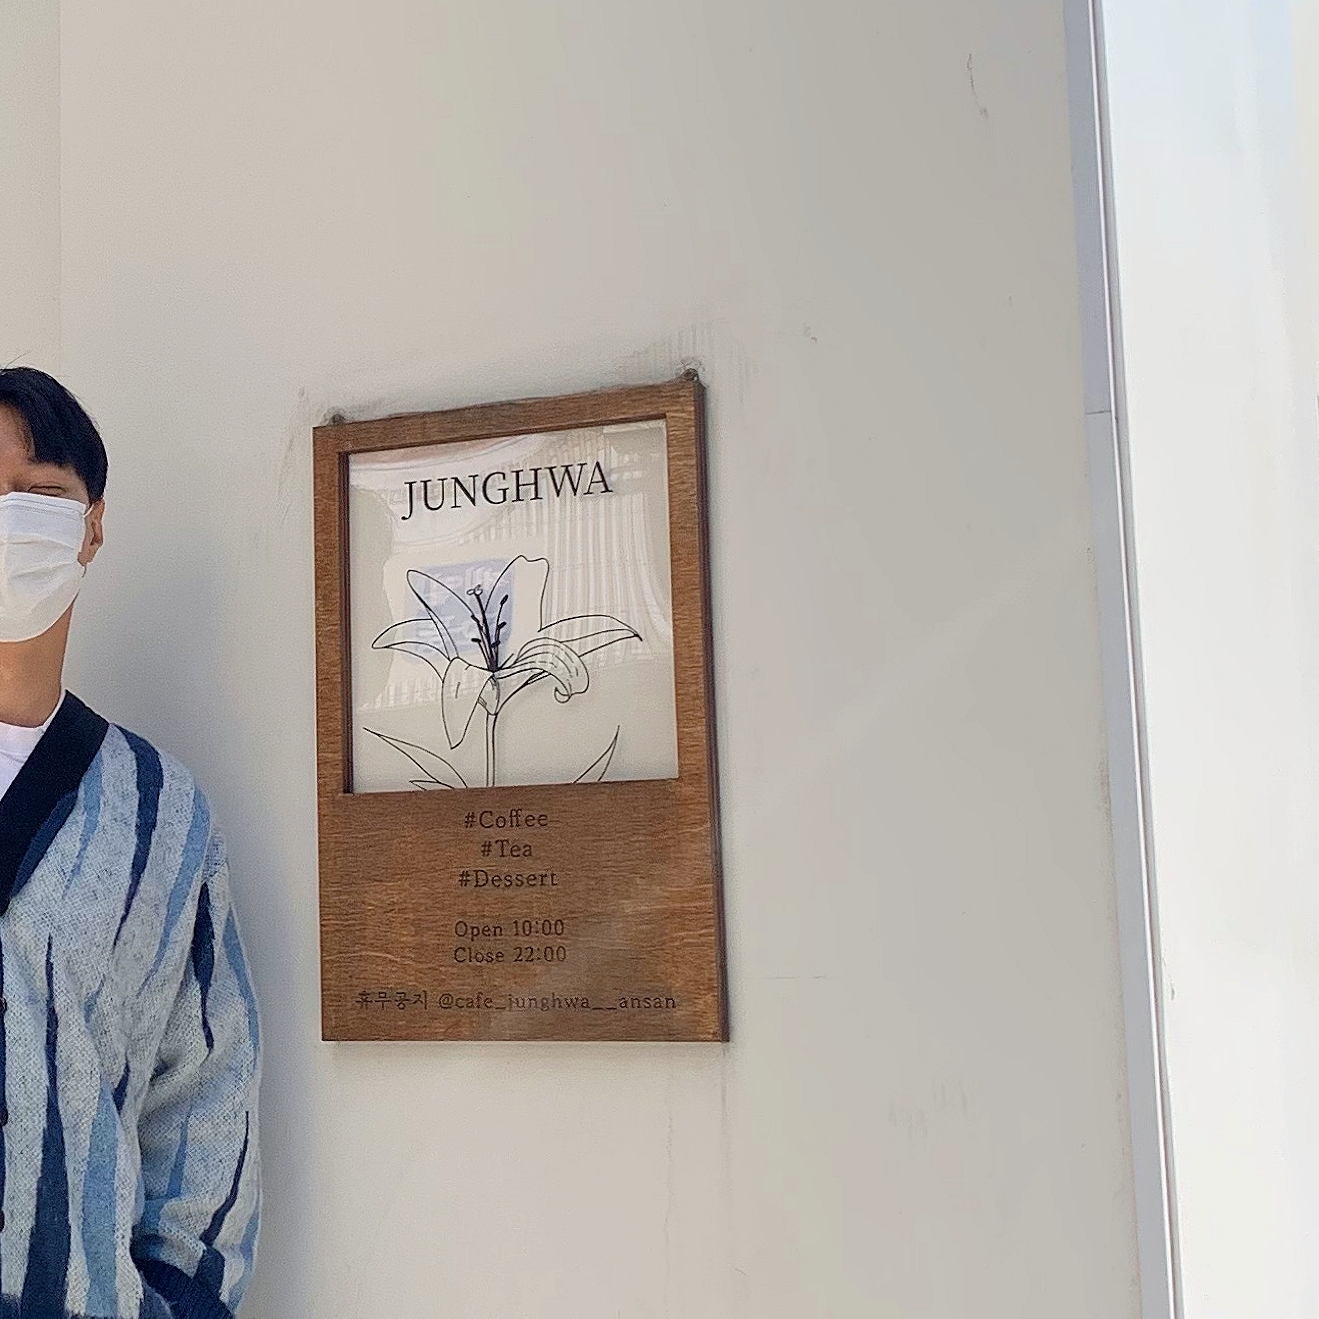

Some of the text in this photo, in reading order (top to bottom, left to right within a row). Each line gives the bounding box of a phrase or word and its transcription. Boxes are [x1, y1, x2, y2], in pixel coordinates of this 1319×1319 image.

[401, 461, 613, 520] JUNGHWA
[464, 808, 548, 829] #Coffee
[480, 839, 533, 858] #Tea
[458, 869, 559, 889] #Dessert
[454, 919, 565, 941] Open 10:00
[454, 946, 567, 963] Close 22:00
